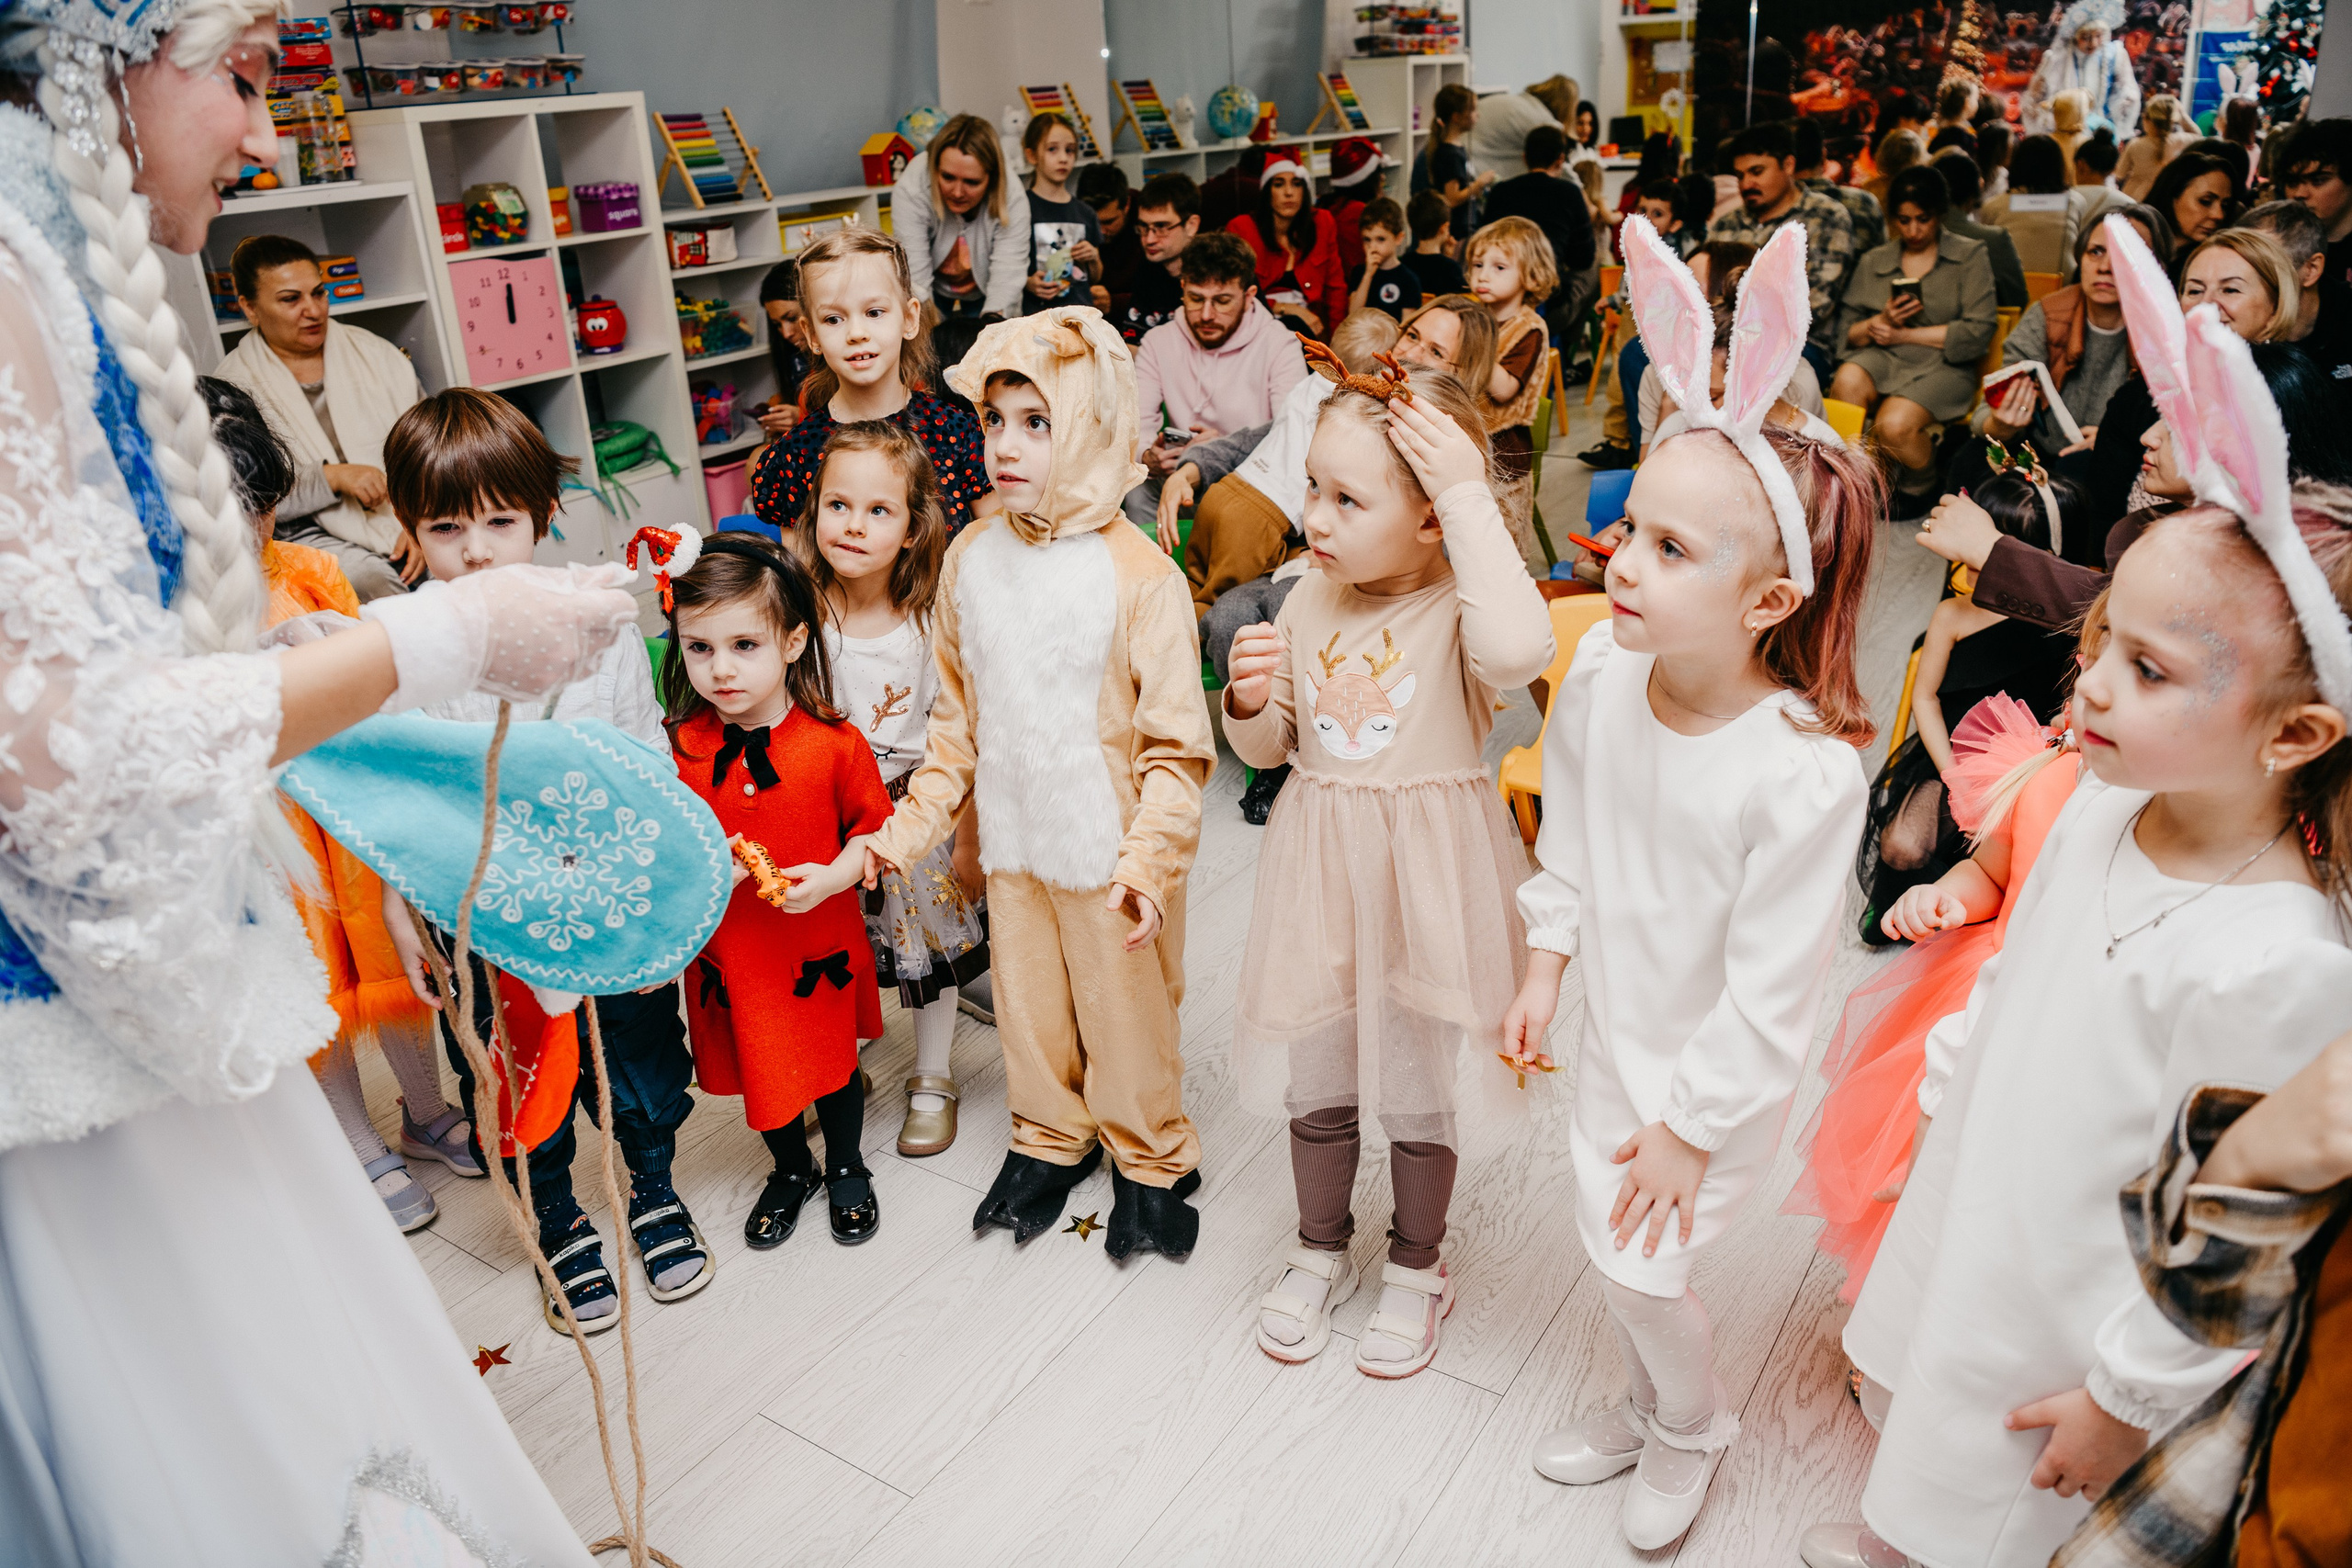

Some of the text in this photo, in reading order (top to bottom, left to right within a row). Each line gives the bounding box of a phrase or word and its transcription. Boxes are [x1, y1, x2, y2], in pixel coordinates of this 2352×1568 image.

[497, 267, 510, 280] 12
[522, 270, 528, 281] 1
[480, 277, 492, 288] 11
[538, 286, 546, 296] 2
[469, 297, 481, 309] 10
[467, 321, 475, 332] 9
[547, 333, 553, 342] 4
[536, 350, 543, 360] 5
[497, 357, 503, 367] 7
[516, 358, 525, 369] 6
[649, 1208, 670, 1219] kapika
[559, 1243, 581, 1258] kapika
[1399, 1272, 1422, 1282] INDIGO
